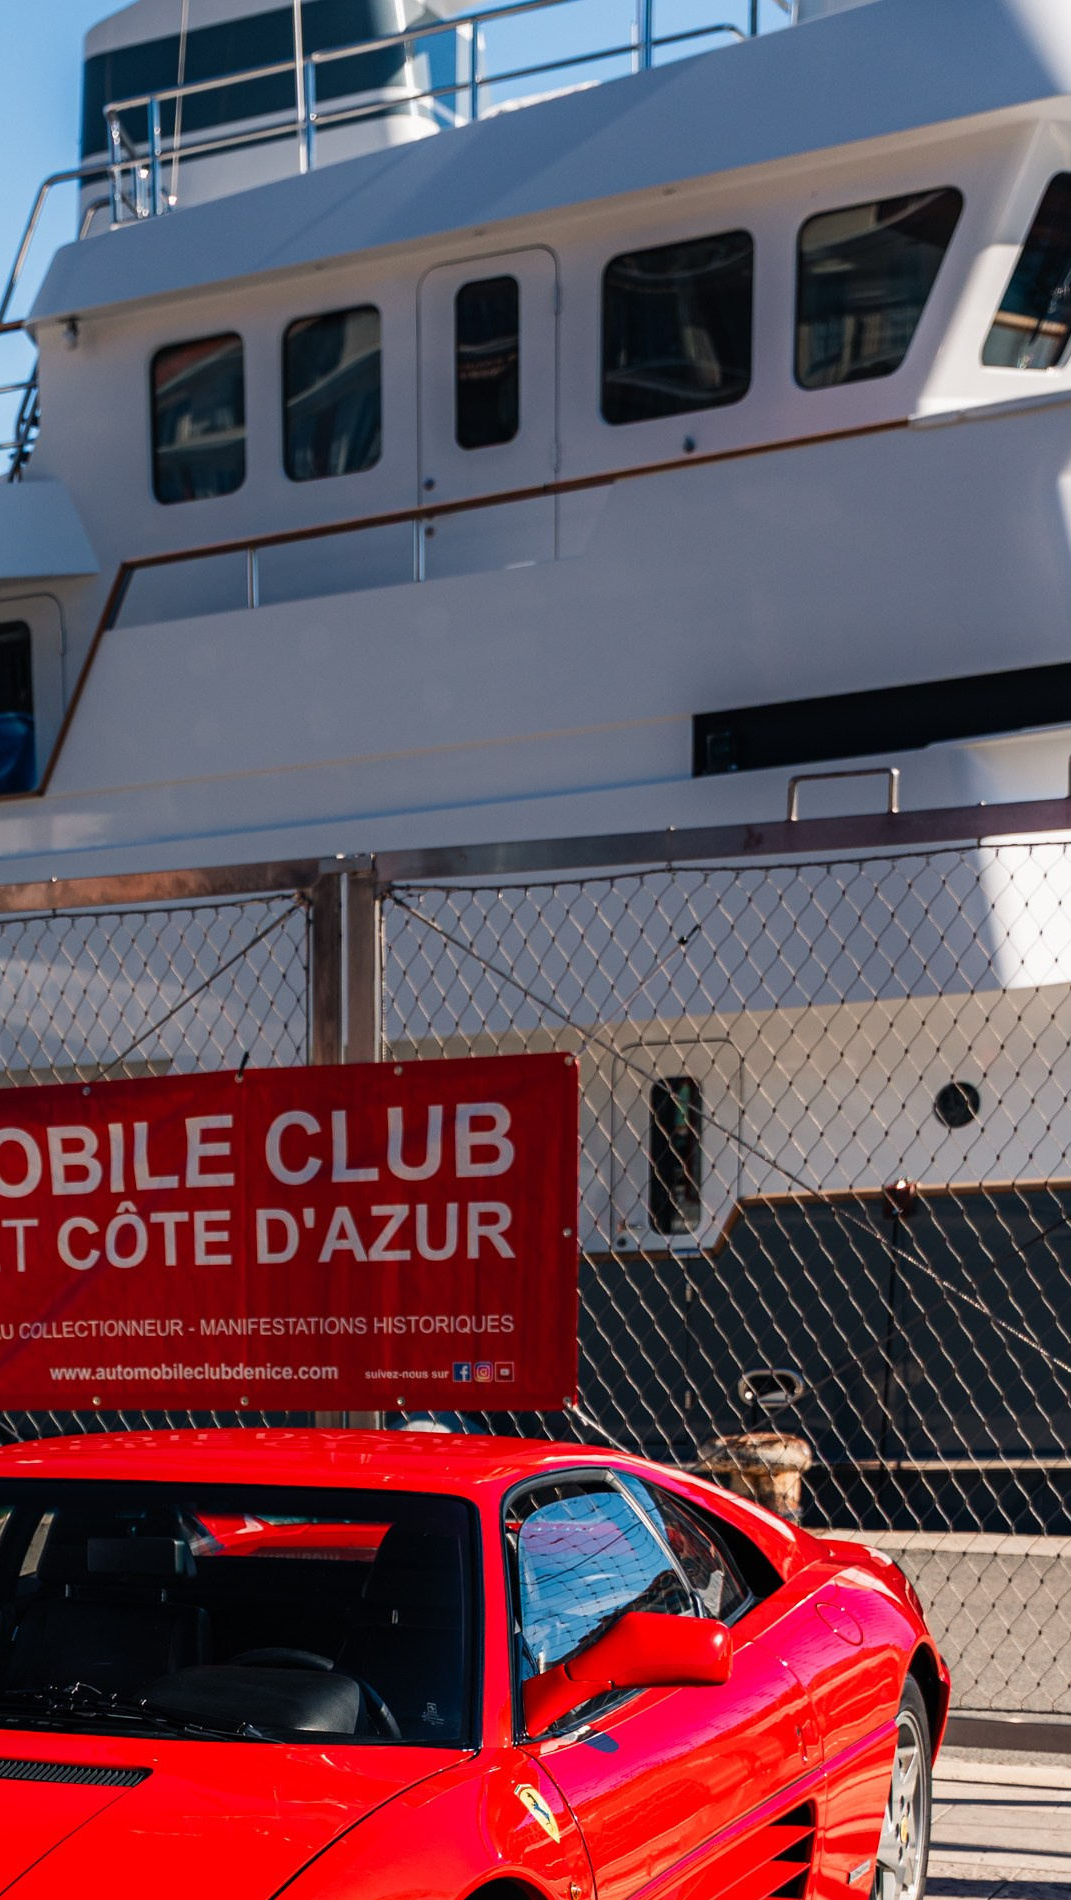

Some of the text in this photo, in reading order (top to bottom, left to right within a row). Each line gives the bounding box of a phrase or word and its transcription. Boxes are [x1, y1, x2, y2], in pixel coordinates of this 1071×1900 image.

[265, 1102, 515, 1186] CLUB
[57, 1201, 232, 1270] CÔTE
[255, 1201, 516, 1265] D'AZUR
[18, 1319, 184, 1340] COLLECTIONNEUR
[200, 1316, 367, 1336] MANIFESTATIONS
[373, 1314, 515, 1334] HISTORIQUES
[49, 1363, 339, 1381] www.automobileclubdenice.com
[364, 1369, 429, 1379] suivez-nous
[431, 1370, 450, 1379] sur
